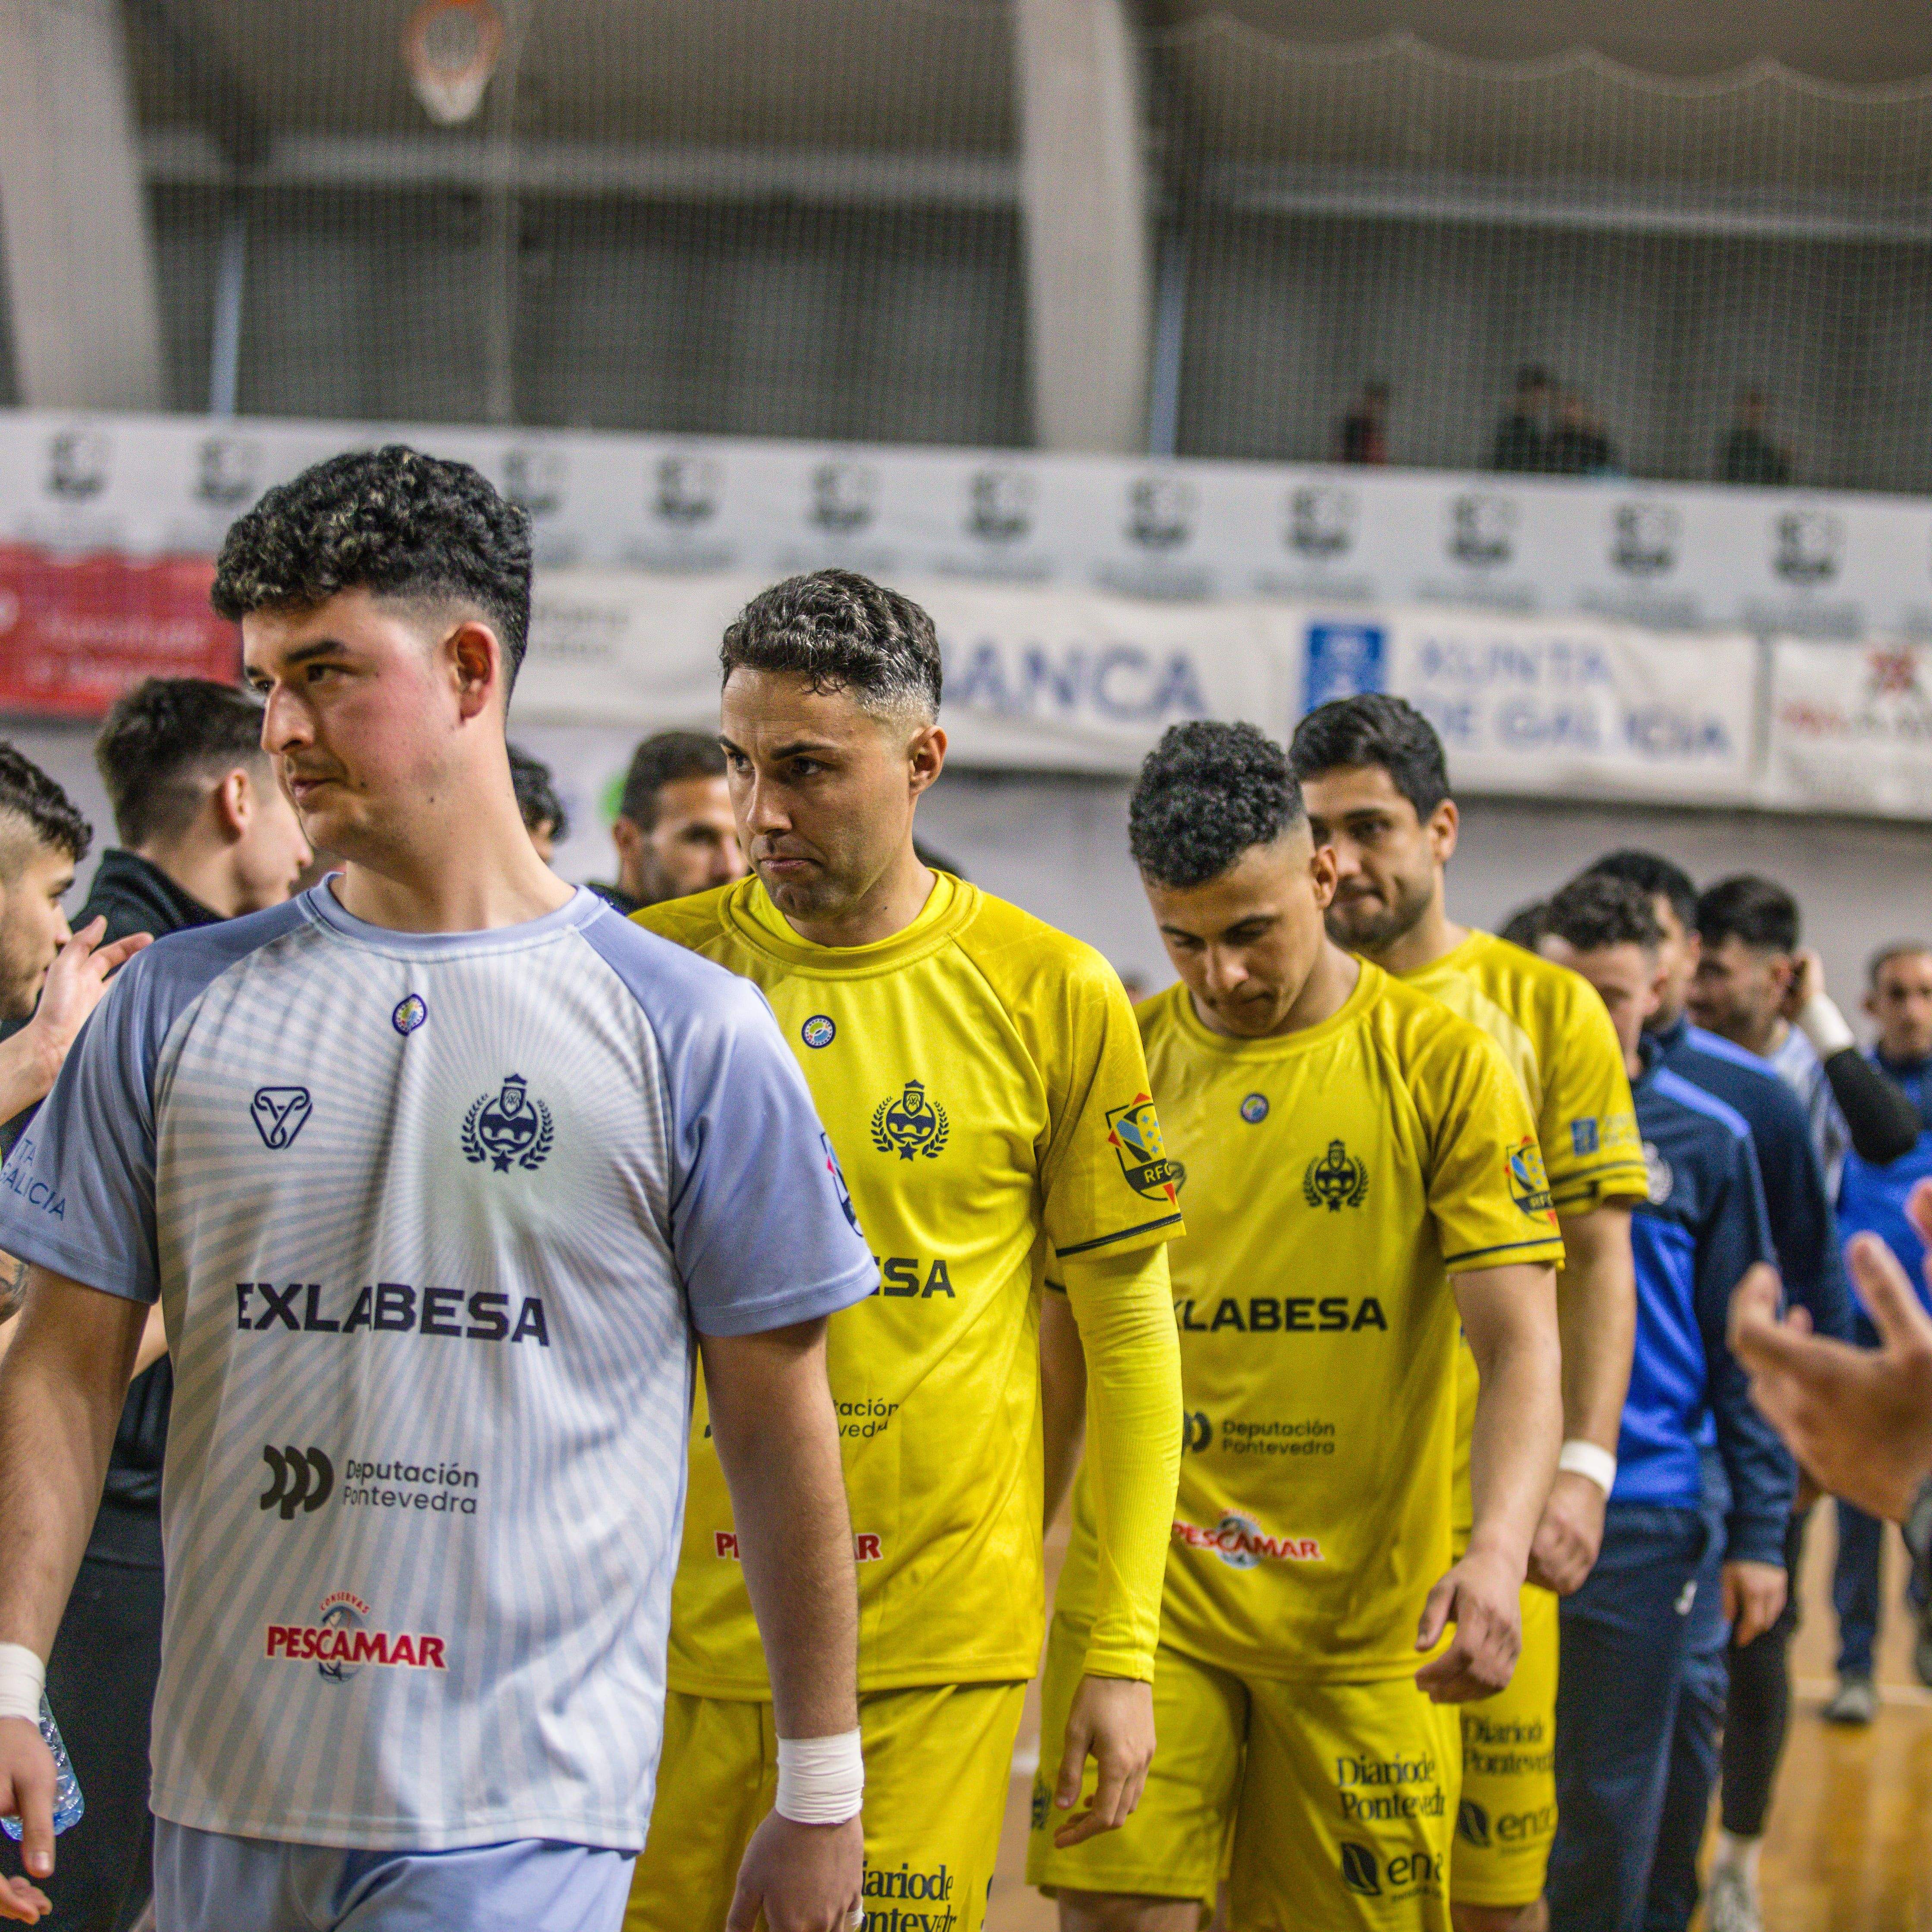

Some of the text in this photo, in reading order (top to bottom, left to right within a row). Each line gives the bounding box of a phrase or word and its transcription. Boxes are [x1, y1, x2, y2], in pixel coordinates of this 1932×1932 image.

[236, 1282, 550, 1347] EXLABESA
[346, 1459, 480, 1488] Deputación
[343, 1486, 477, 1514] Pontevedra
[267, 1626, 446, 1668] PESCAMAR
